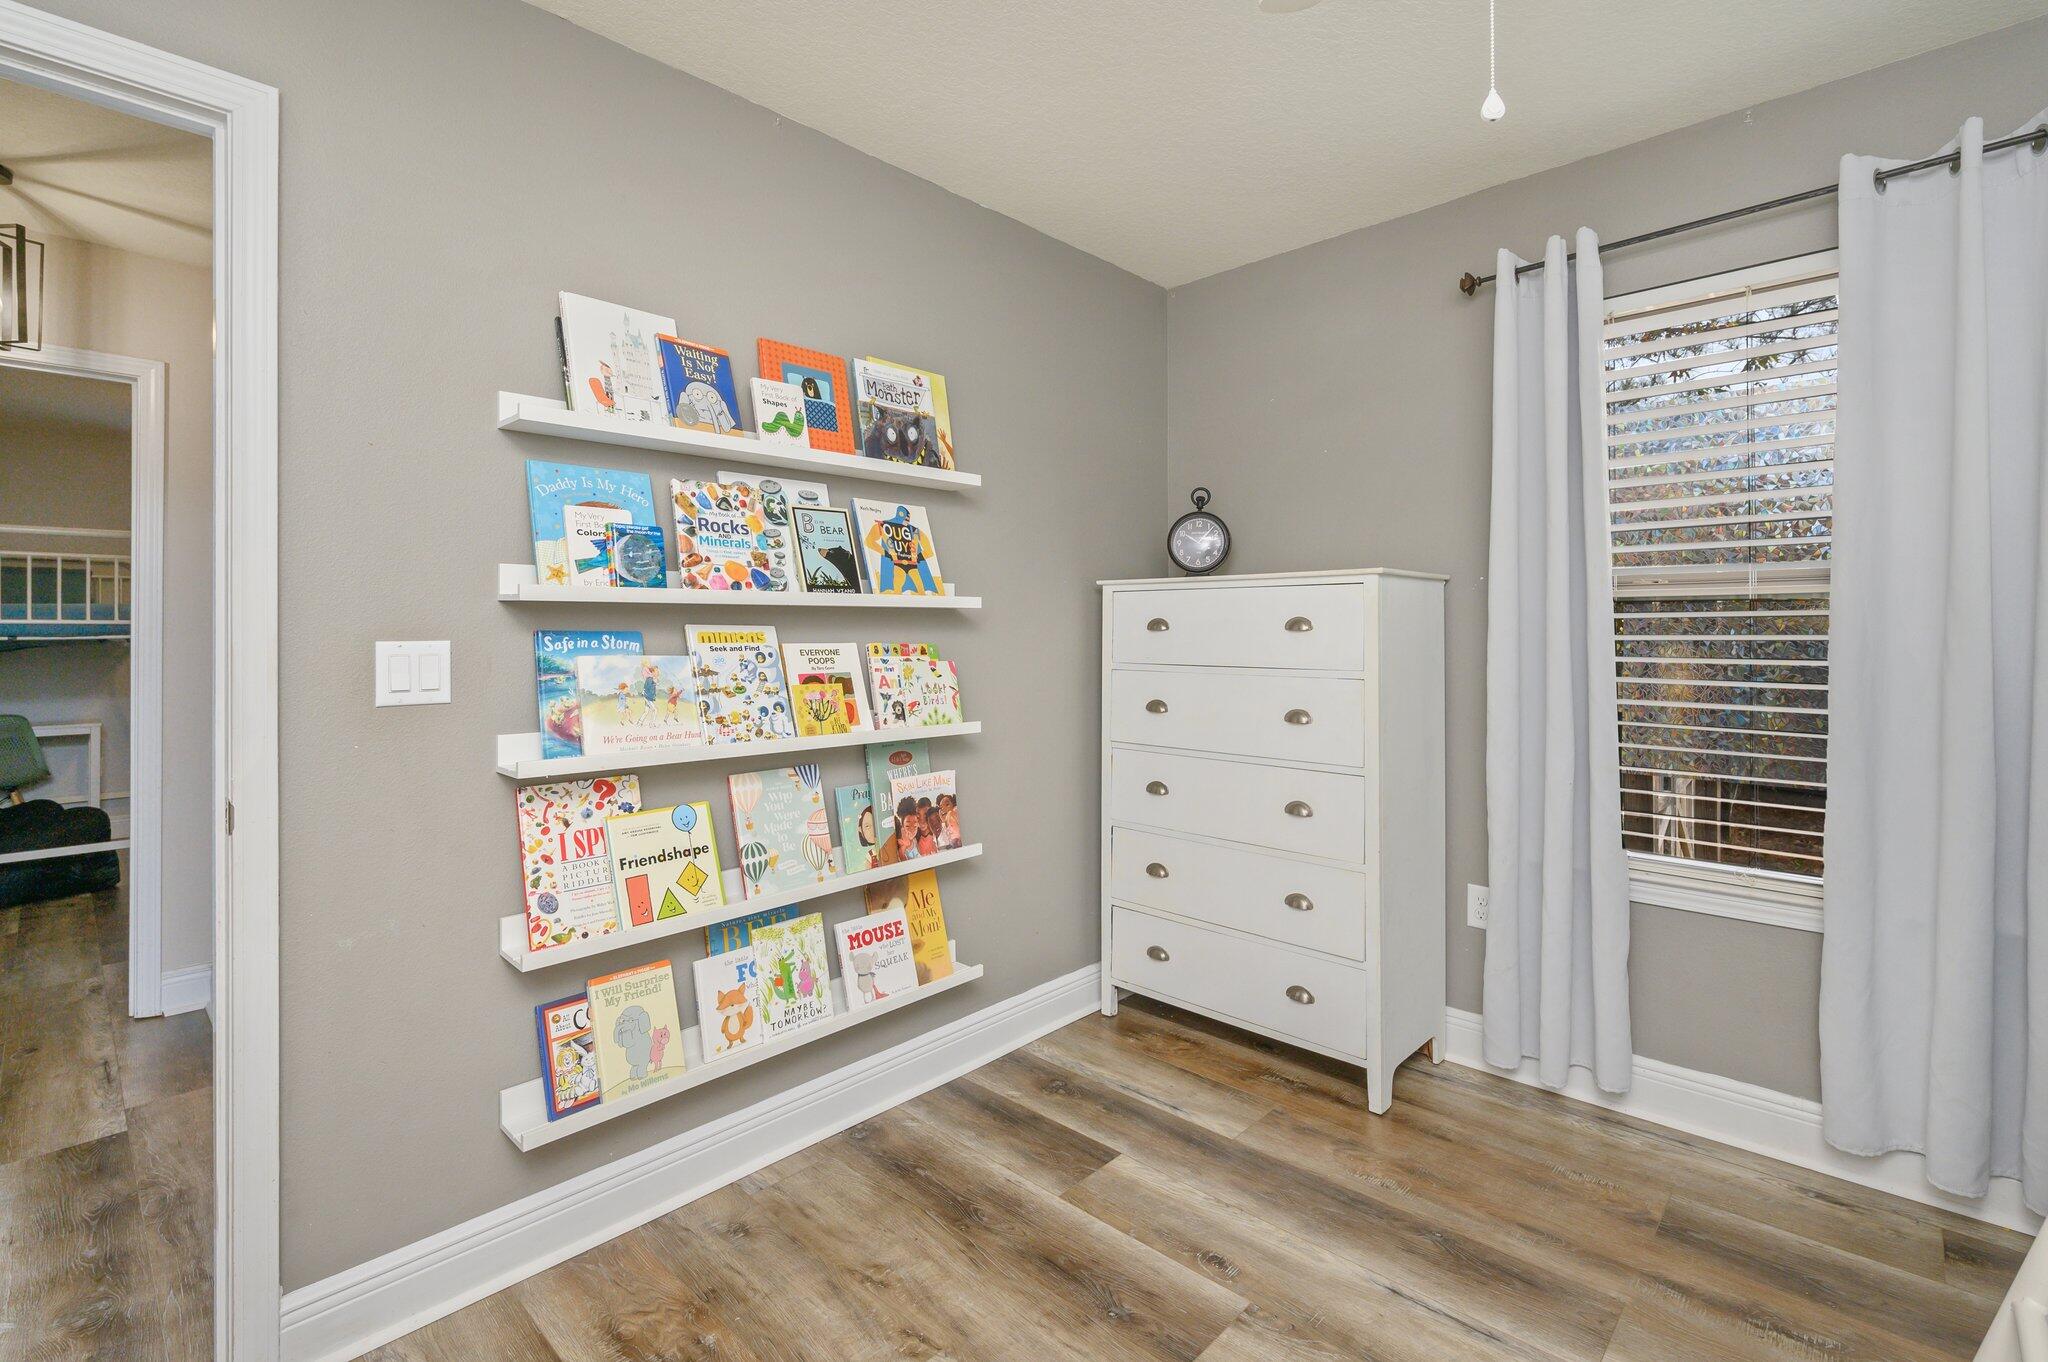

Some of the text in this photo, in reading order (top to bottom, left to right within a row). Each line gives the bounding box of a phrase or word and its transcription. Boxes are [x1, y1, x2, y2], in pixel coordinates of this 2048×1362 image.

[674, 344, 718, 364] Waiting
[681, 356, 717, 373] Is Not
[685, 367, 716, 384] Easy!
[866, 379, 921, 406] Monster
[763, 398, 788, 408] Shapes
[535, 476, 649, 507] Daddy Is My Hero
[574, 511, 605, 521] My Very
[801, 512, 814, 534] B
[820, 525, 845, 535] BEAR
[576, 528, 607, 537] Colors
[594, 521, 605, 529] Bo
[698, 517, 749, 535] Rocks
[699, 535, 751, 549] Minerals
[543, 634, 641, 653] Safe in a Storm
[799, 648, 841, 657] EVERYONE
[808, 657, 836, 665] POOPS
[879, 674, 901, 689] Ani
[603, 735, 623, 744] We're
[625, 733, 648, 744] Going
[666, 731, 682, 740] Bear
[886, 763, 918, 780] WHERE'S
[768, 791, 793, 804] Who
[880, 792, 894, 812] BA
[763, 801, 784, 812] You
[774, 809, 800, 821] Were
[763, 820, 793, 835] Made
[558, 832, 569, 862] I
[572, 860, 600, 871] BOOK
[619, 844, 709, 871] Friendshape
[562, 866, 609, 881] PICTUR
[563, 874, 611, 890] RIDDLE
[911, 888, 935, 910] Me
[911, 916, 941, 937] Mom!
[847, 920, 905, 951] MOUSE
[875, 952, 909, 970] SQUEAK
[736, 959, 757, 983] FO
[594, 973, 670, 1001] I Will Surprise
[604, 984, 662, 1008] My Friend!
[784, 1000, 815, 1017] MAYBE
[770, 1004, 827, 1031] TOMORROW?
[628, 1083, 640, 1093] Mo
[641, 1073, 670, 1088] Willems
